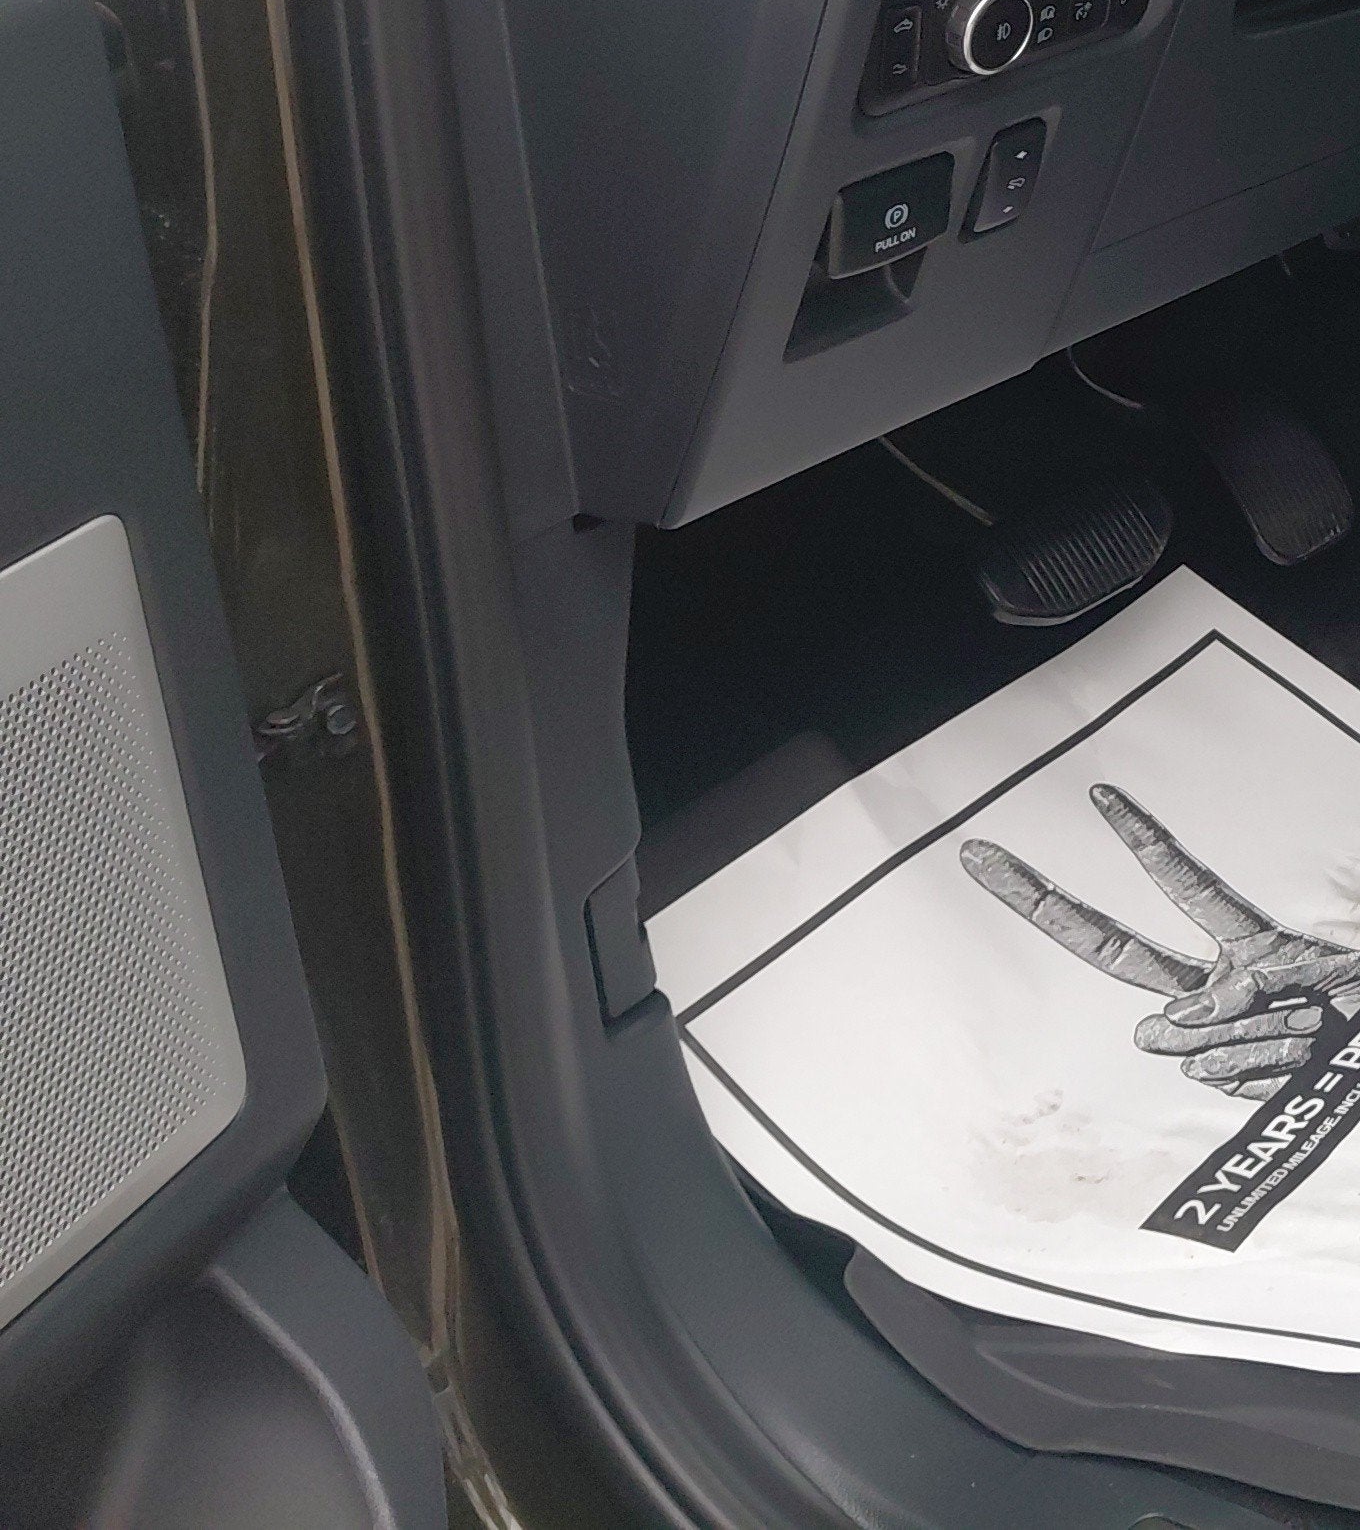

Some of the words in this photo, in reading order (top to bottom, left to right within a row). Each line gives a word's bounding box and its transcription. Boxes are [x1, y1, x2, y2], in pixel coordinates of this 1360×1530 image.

[875, 234, 900, 253] PULL
[900, 226, 917, 242] ON
[1197, 1095, 1325, 1194] YEARS
[1174, 1200, 1221, 1225] 2
[1217, 1169, 1289, 1232] UNLIMITED
